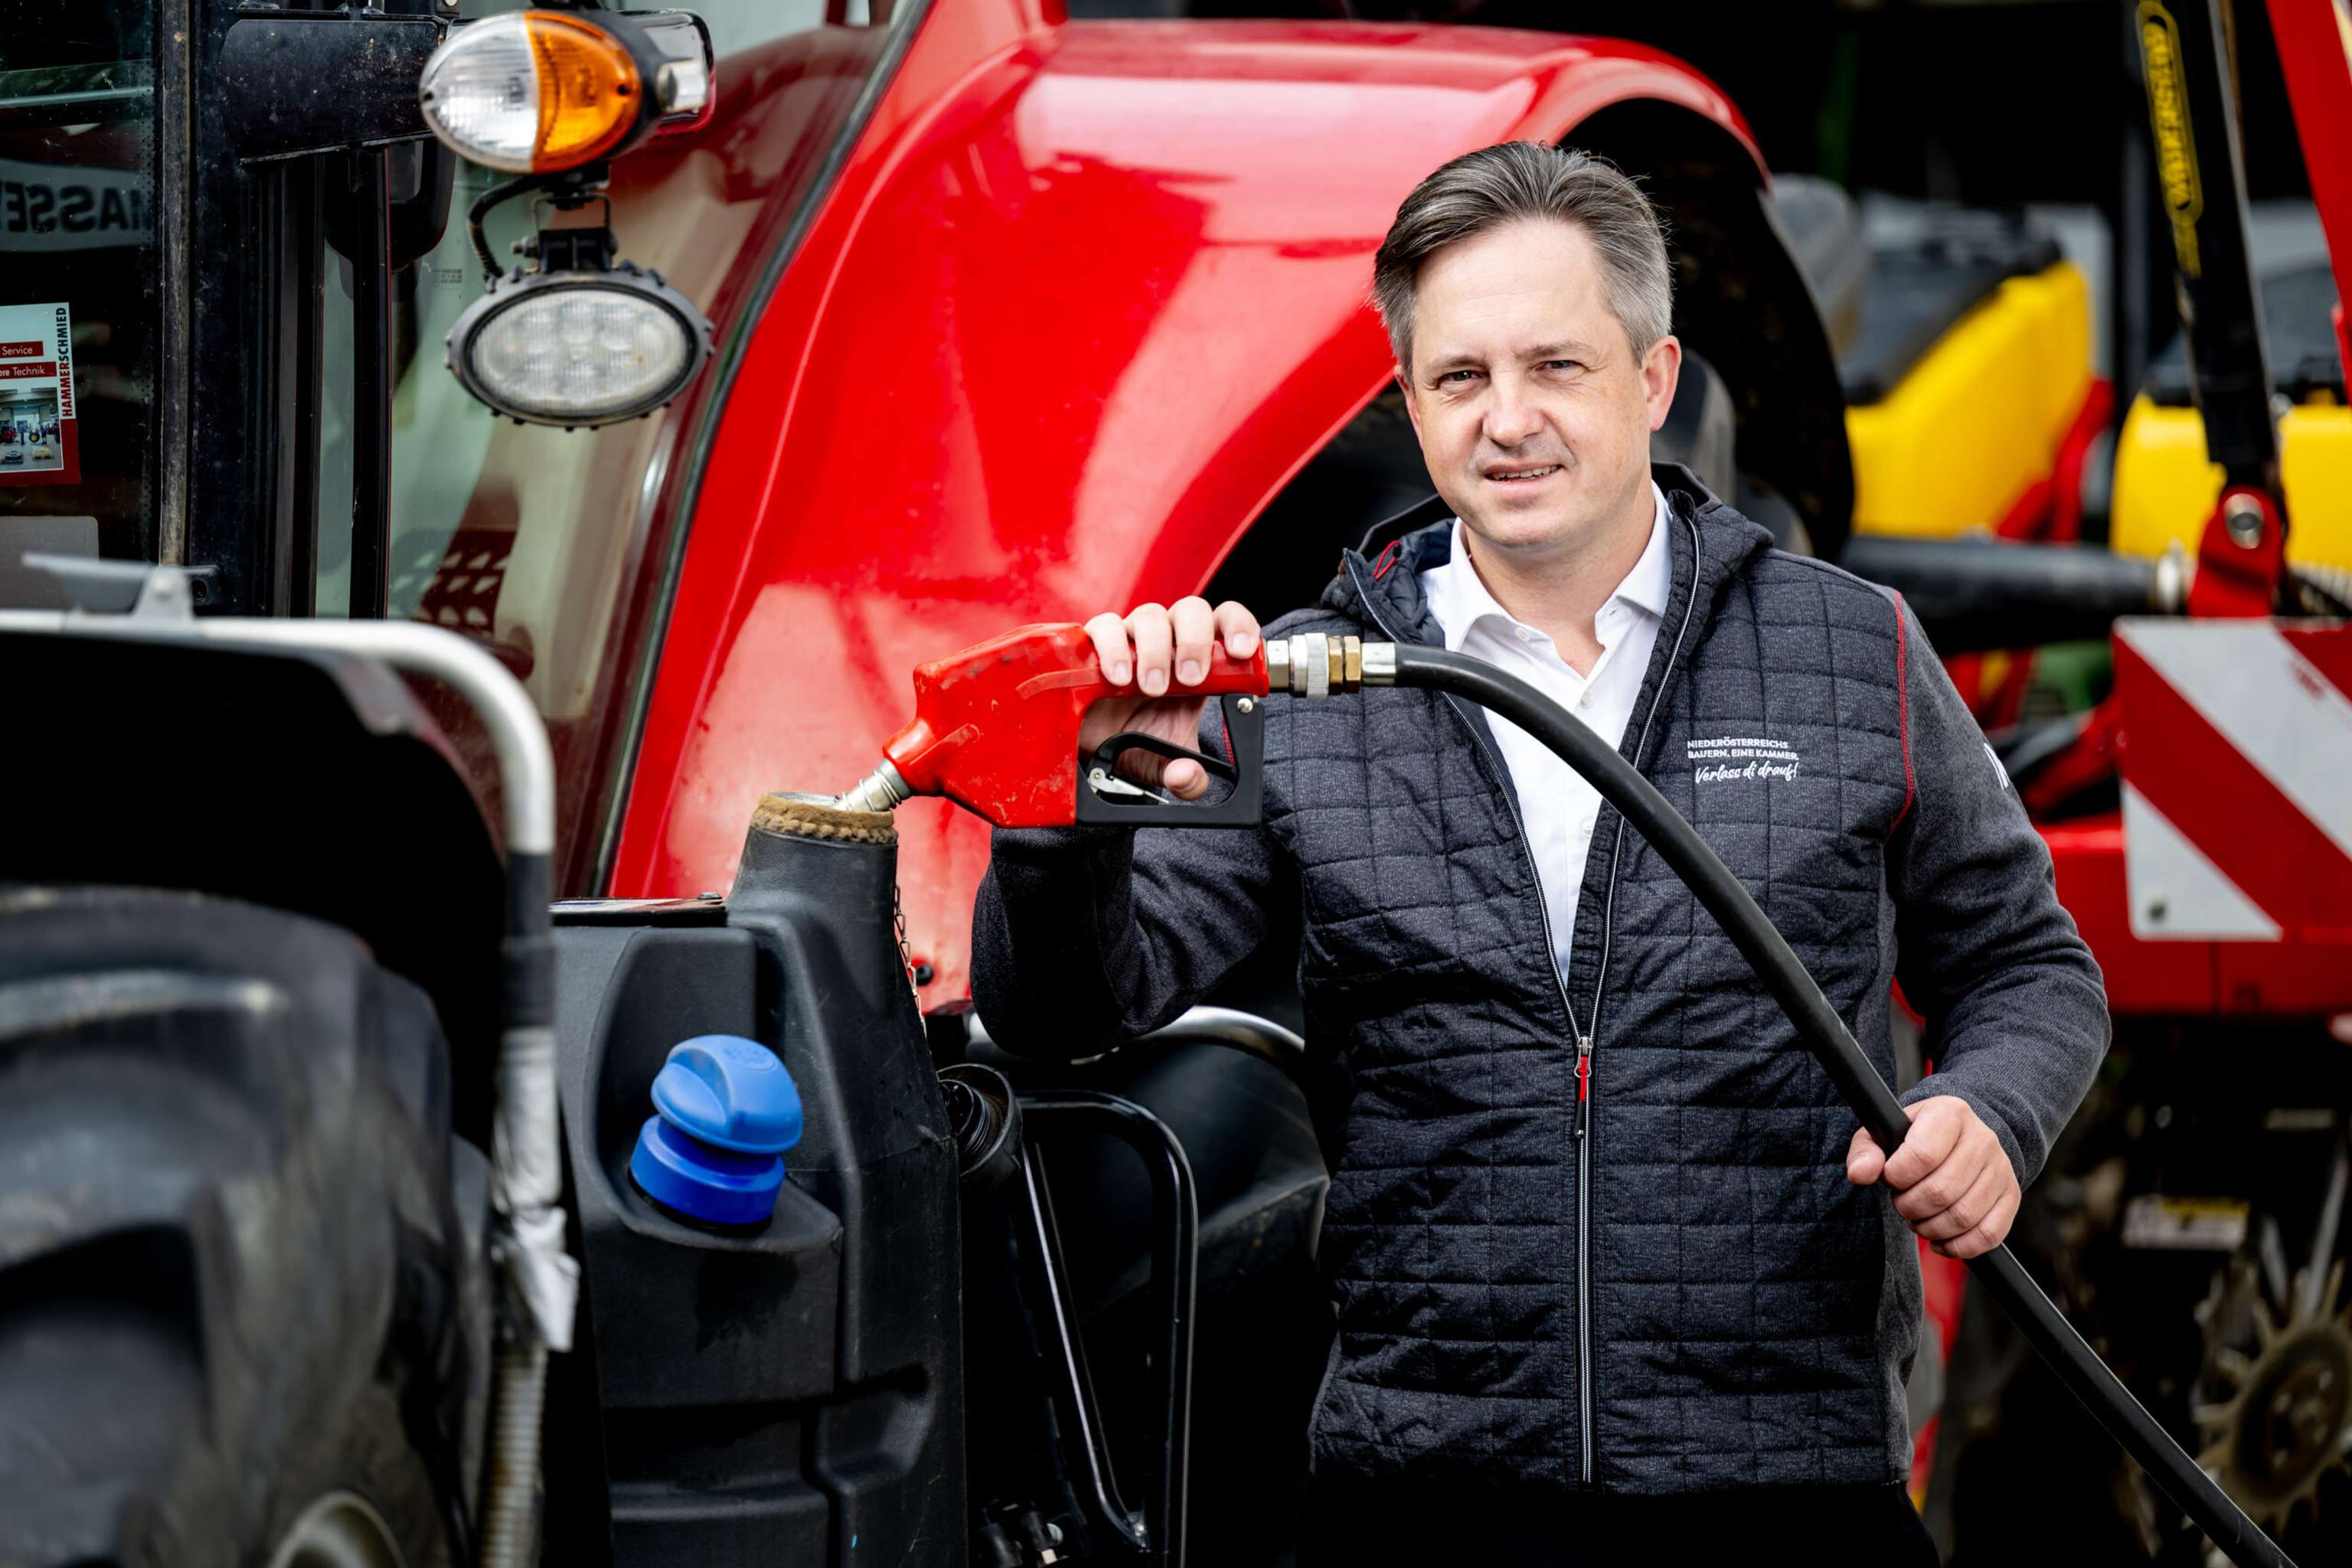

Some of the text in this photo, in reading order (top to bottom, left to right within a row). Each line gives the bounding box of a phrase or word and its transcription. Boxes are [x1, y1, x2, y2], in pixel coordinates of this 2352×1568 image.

[2, 345, 33, 356] Service
[56, 307, 73, 416] HAMMERSCHMIED
[12, 365, 46, 376] Technik
[1687, 737, 1788, 749] NIEDERÖSTERREICHS
[1687, 749, 1799, 760] BAUERN. EINE KAMMER.
[1695, 760, 1799, 784] Verlass di drauf!
